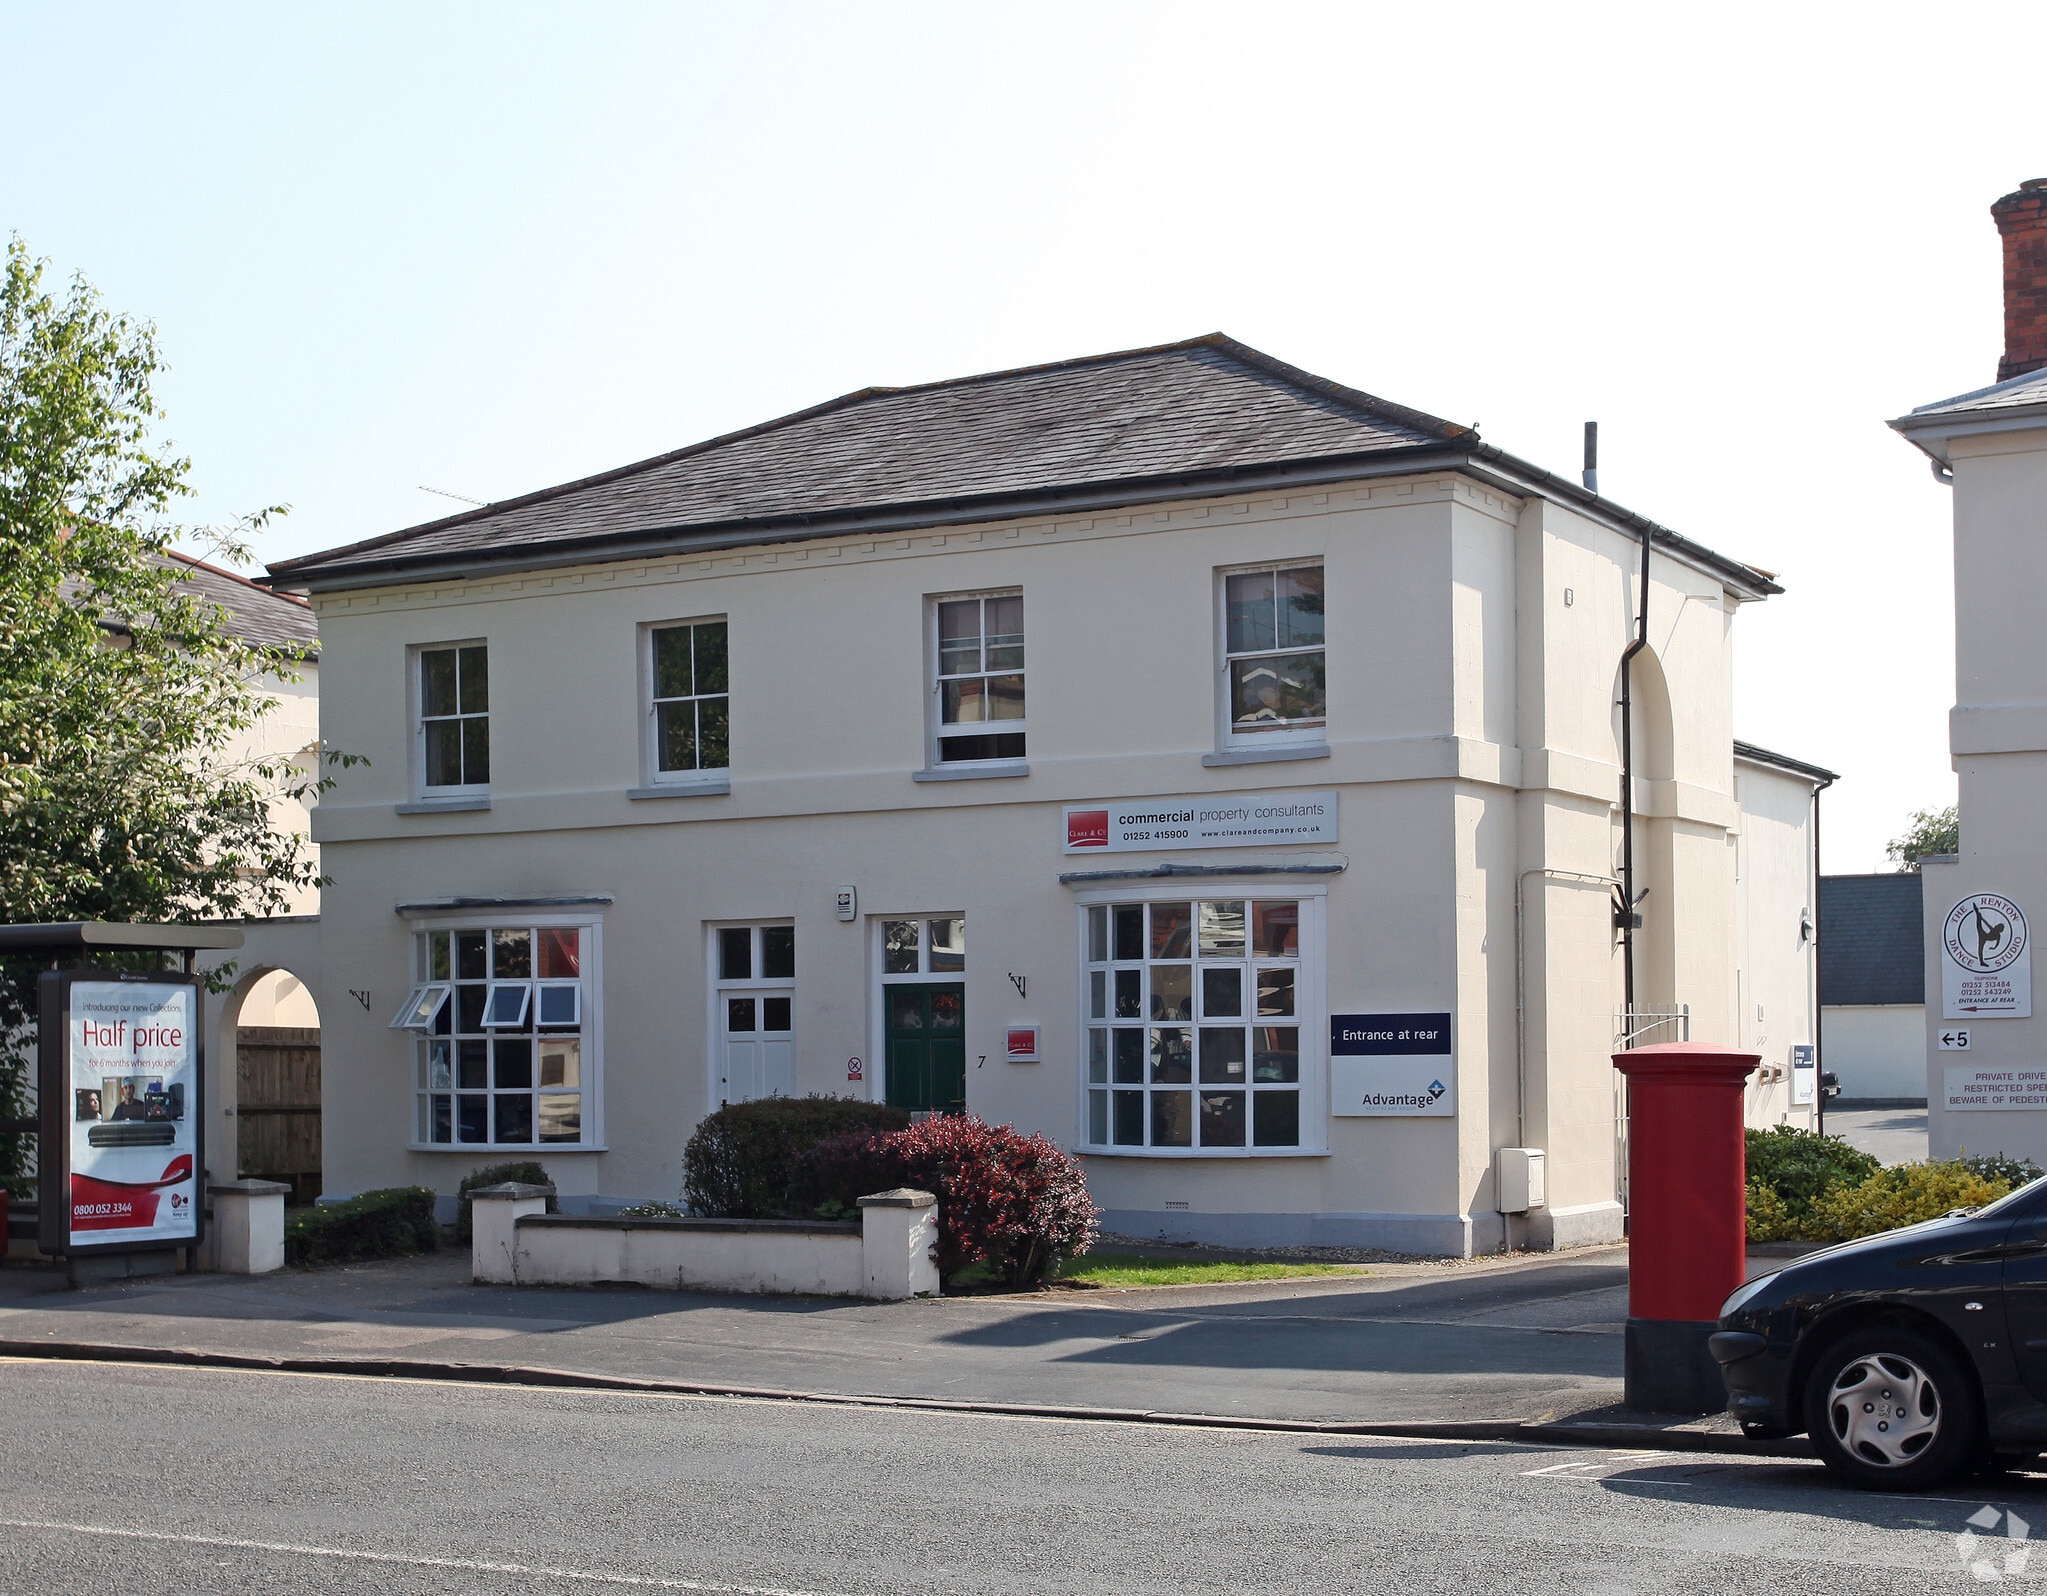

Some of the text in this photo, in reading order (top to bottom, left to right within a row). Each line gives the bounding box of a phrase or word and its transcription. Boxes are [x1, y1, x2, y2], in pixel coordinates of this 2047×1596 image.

[1119, 803, 1324, 825] commercial property consultants
[1123, 829, 1189, 841] 01252 415900
[1201, 825, 1321, 837] www.clareandcompany.co.uk
[1951, 905, 1968, 924] THE
[1980, 898, 2019, 922] RENTON
[1949, 938, 1975, 968] DANCE
[1994, 936, 2022, 968] STUDIO
[1962, 981, 1982, 989] 01252
[1984, 988, 2012, 996] 543249
[83, 1002, 118, 1013] Introducing
[149, 1003, 182, 1013] Collections
[83, 1019, 182, 1055] Half price
[1343, 1029, 1438, 1040] Entrance at rear
[1957, 1032, 1968, 1047] 5
[89, 1058, 176, 1070] for 6 months when you join
[978, 1055, 986, 1068] 7
[1975, 1072, 2046, 1080] PRIVATE DRIVE
[1964, 1084, 2023, 1092] RESTRICTED
[1362, 1093, 1433, 1108] Advantage
[1949, 1095, 2047, 1104] BEWARE OF PEDEST
[74, 1202, 132, 1215] 0800 052 3344
